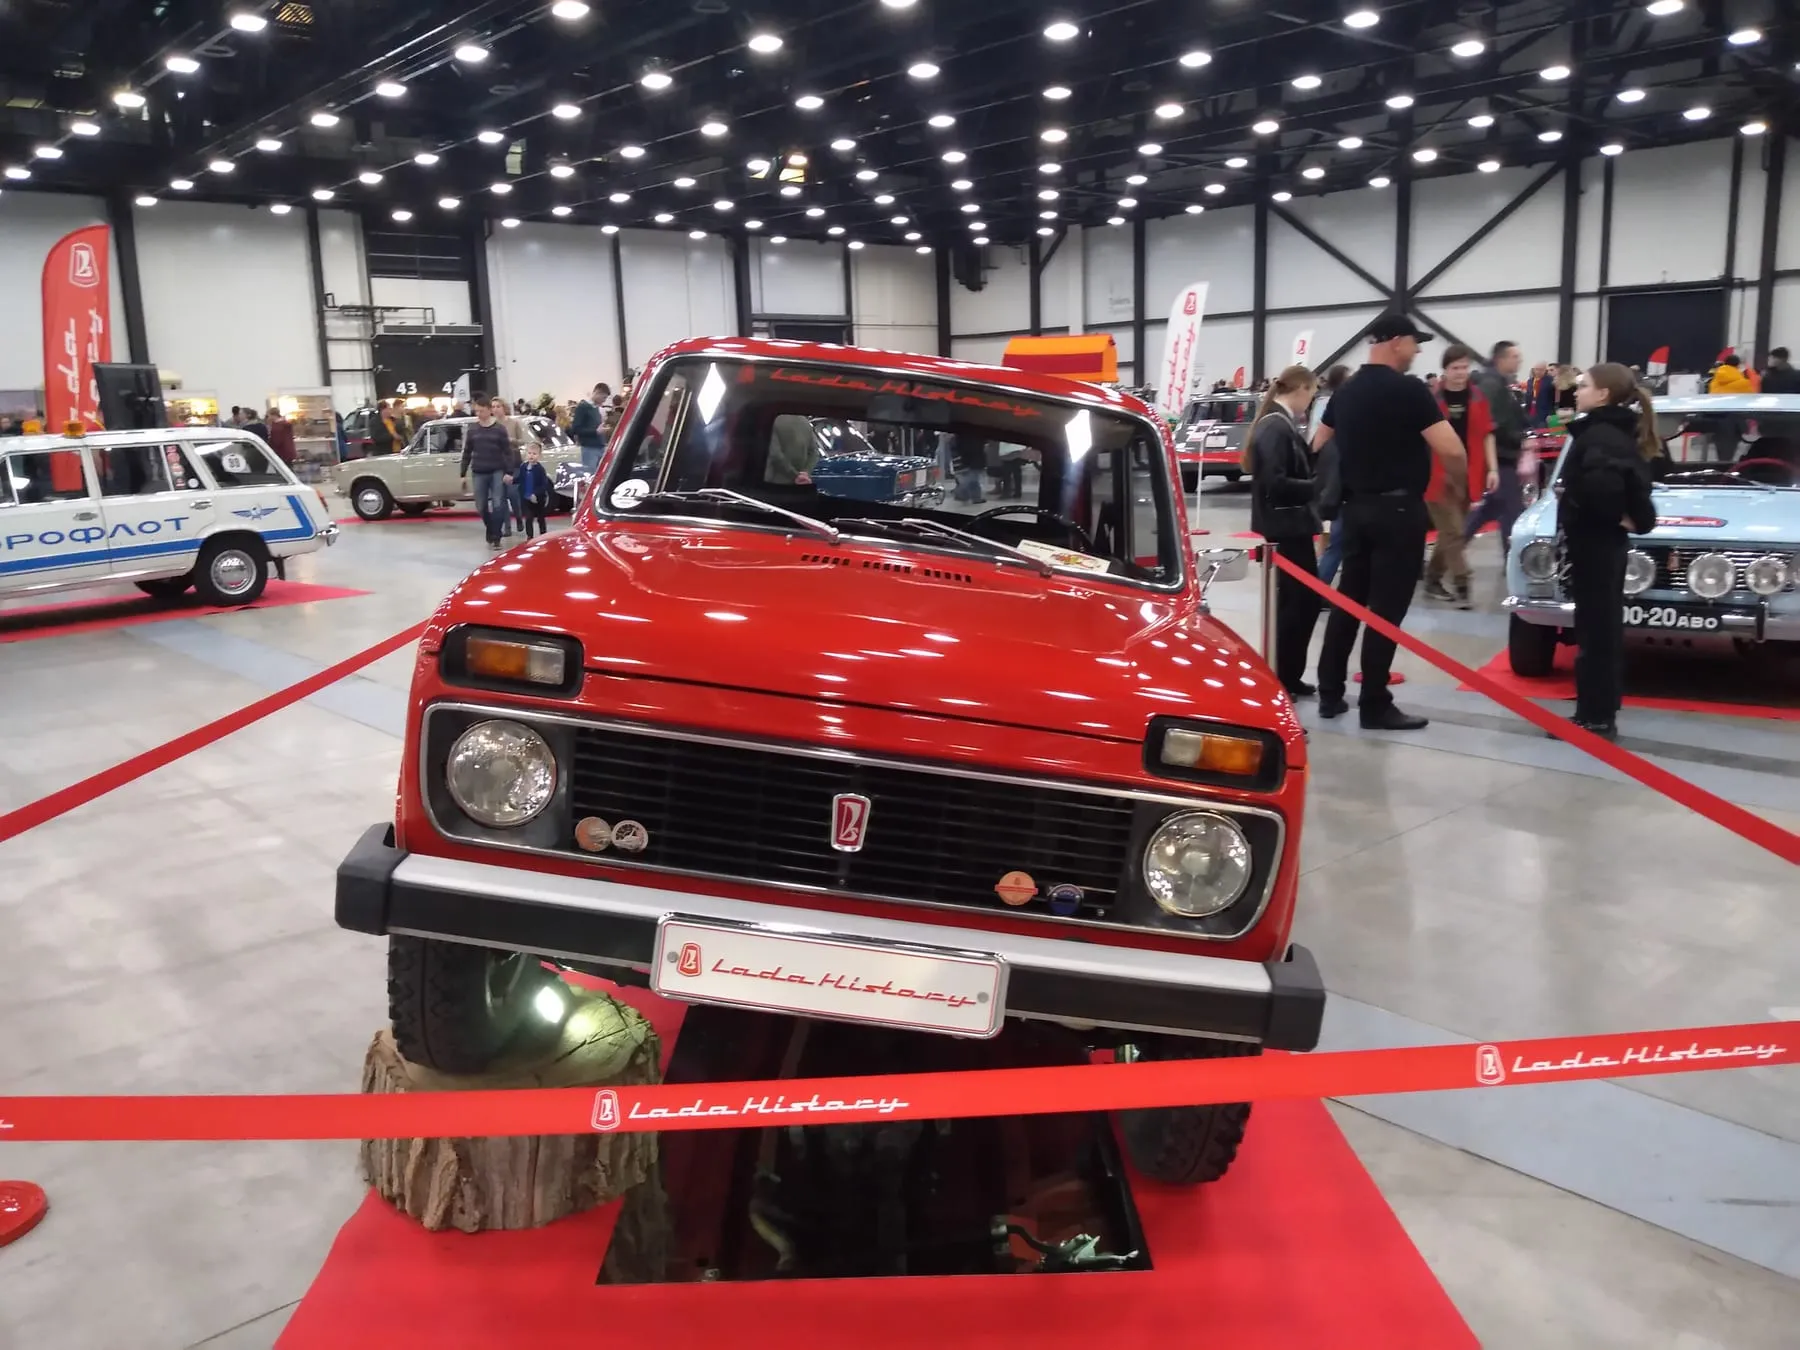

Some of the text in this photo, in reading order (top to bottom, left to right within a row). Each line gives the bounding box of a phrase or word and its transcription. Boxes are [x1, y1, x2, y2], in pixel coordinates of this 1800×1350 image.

[396, 382, 418, 395] 43
[769, 368, 1042, 416] Lada History
[622, 488, 638, 498] 21
[0, 516, 190, 550] РОФЛОТ
[711, 958, 977, 1008] Lada History
[1511, 1042, 1788, 1073] Lada History
[628, 1094, 909, 1119] Lada History
